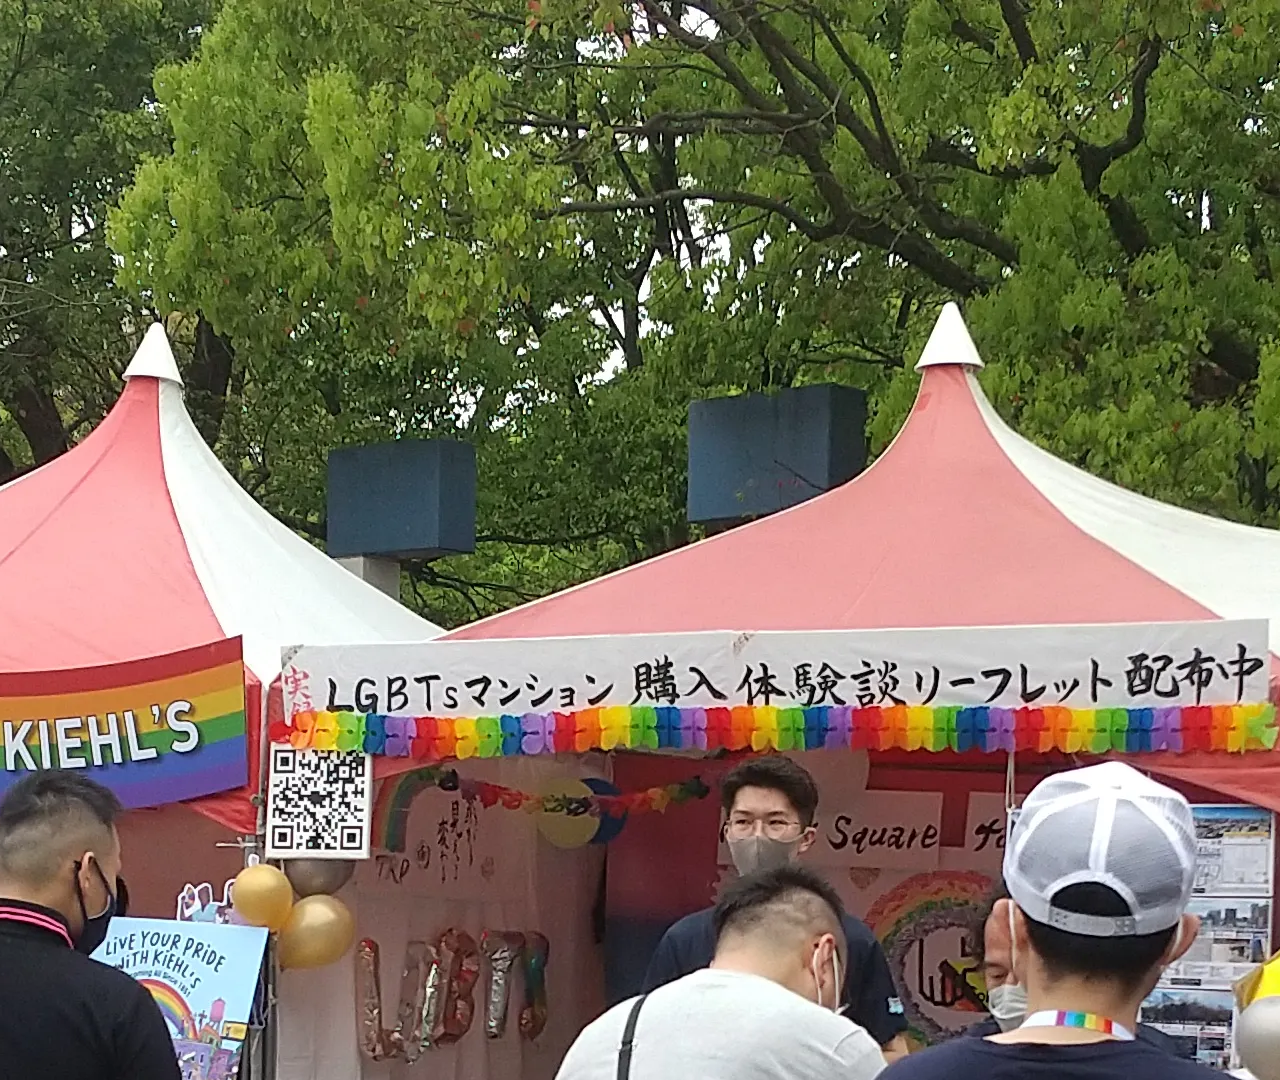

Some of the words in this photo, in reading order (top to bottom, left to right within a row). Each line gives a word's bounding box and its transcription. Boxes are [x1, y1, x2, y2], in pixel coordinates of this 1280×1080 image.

[3, 700, 200, 771] KIEHL'S
[827, 816, 939, 853] Square
[141, 930, 182, 951] YOUR
